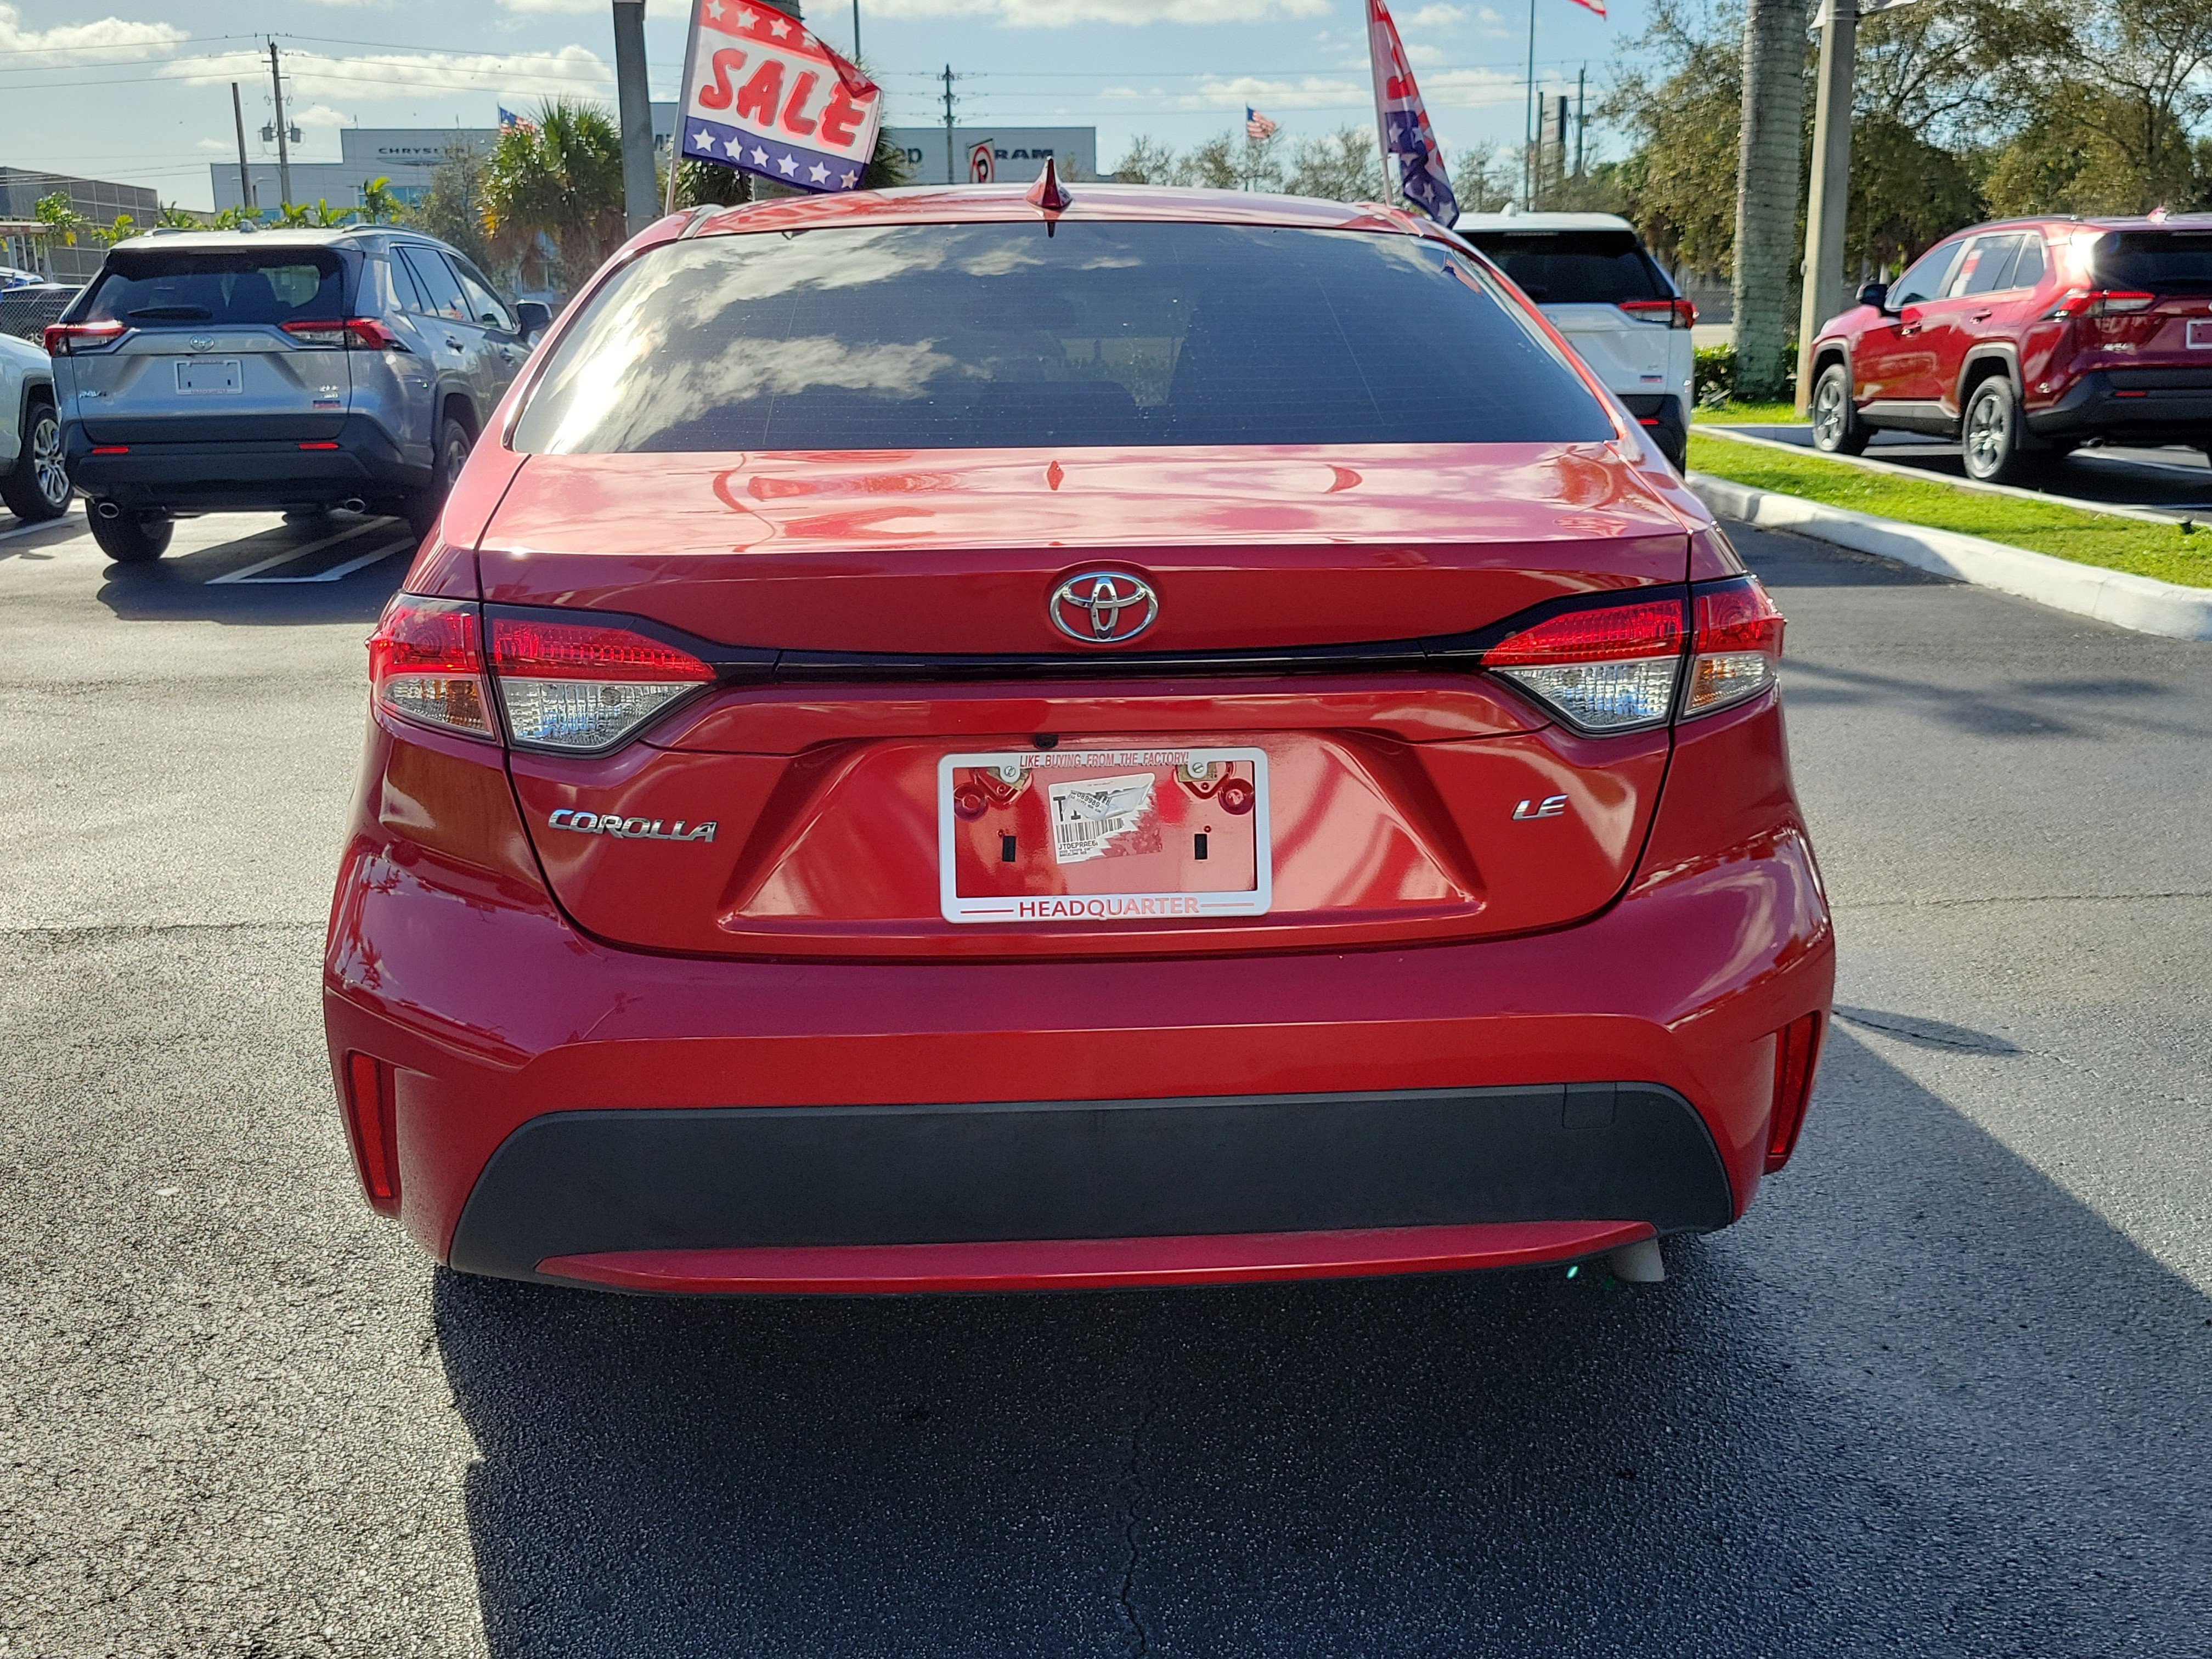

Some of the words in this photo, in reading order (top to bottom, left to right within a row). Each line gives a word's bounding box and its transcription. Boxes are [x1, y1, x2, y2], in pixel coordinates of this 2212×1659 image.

[698, 48, 877, 148] SALE
[995, 149, 1053, 159] RAM
[1019, 755, 1040, 768] LIKE
[1045, 754, 1081, 767] BUYING
[1087, 753, 1115, 766] FROM
[1120, 752, 1138, 765] THE
[1143, 752, 1189, 765] FACTORY!
[1511, 794, 1568, 820] LE
[548, 808, 717, 843] COROLLA
[1019, 896, 1200, 917] HEADQUARTER
